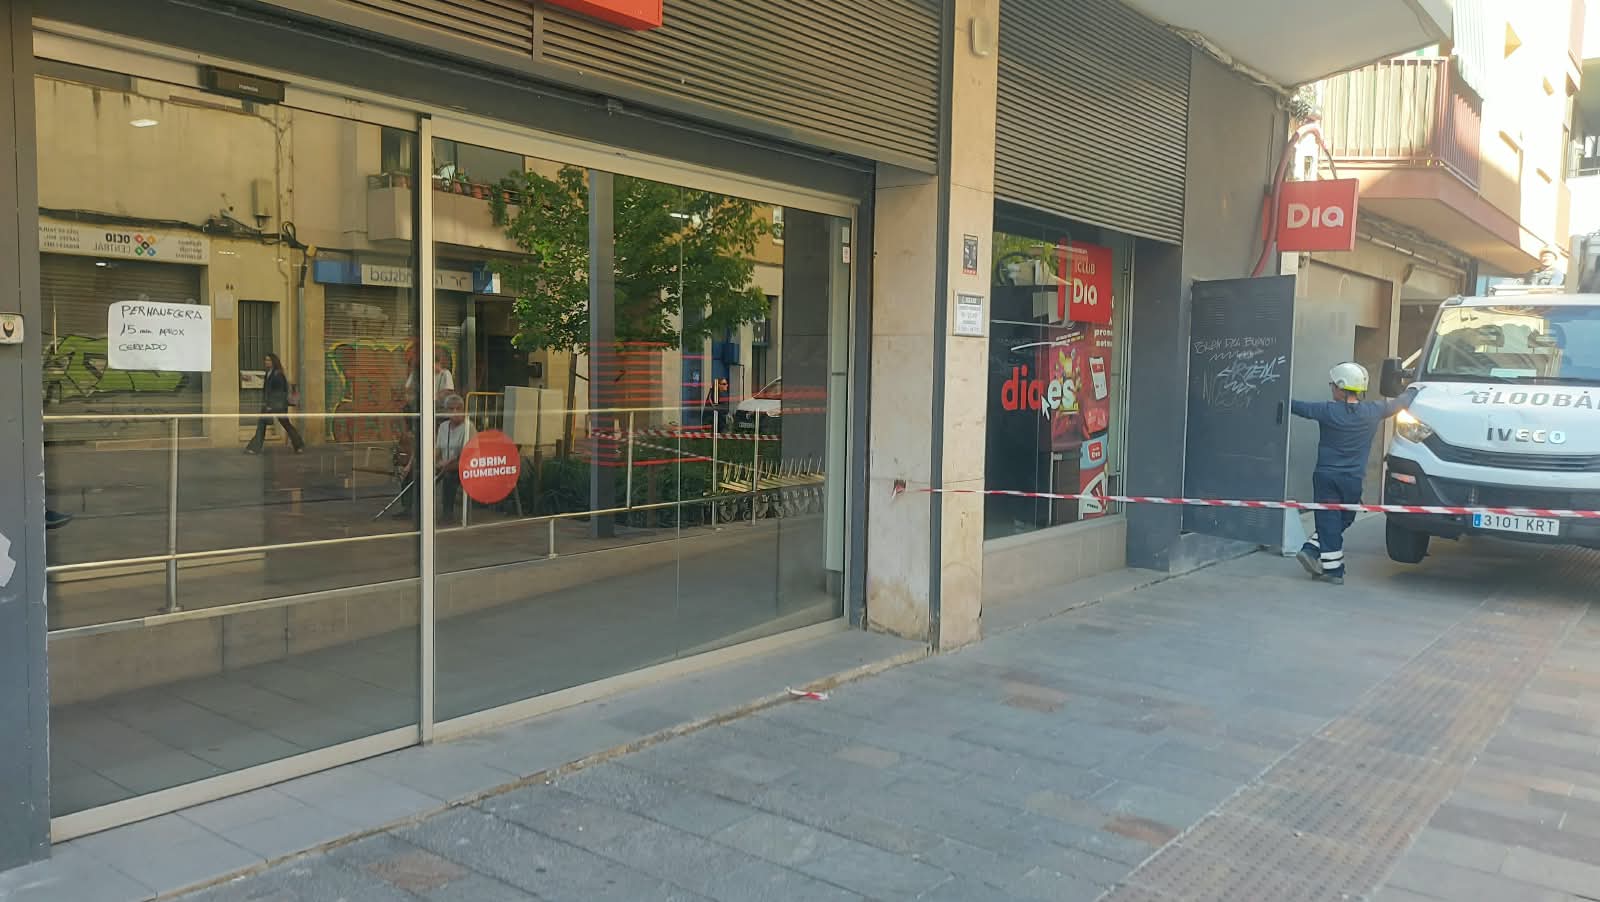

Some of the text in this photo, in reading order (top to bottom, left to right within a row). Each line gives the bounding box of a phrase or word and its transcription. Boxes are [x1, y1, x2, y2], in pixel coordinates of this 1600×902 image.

[1287, 203, 1344, 229] Dia
[1073, 278, 1097, 305] Dia
[120, 323, 137, 337] 15
[118, 343, 168, 352] CERRADO
[1471, 390, 1600, 409] GLOOBA
[1486, 427, 1567, 444] IVECO
[470, 455, 507, 468] OBRIM
[462, 465, 517, 480] DIUMENGES
[1483, 514, 1555, 532] 3101 KRT
